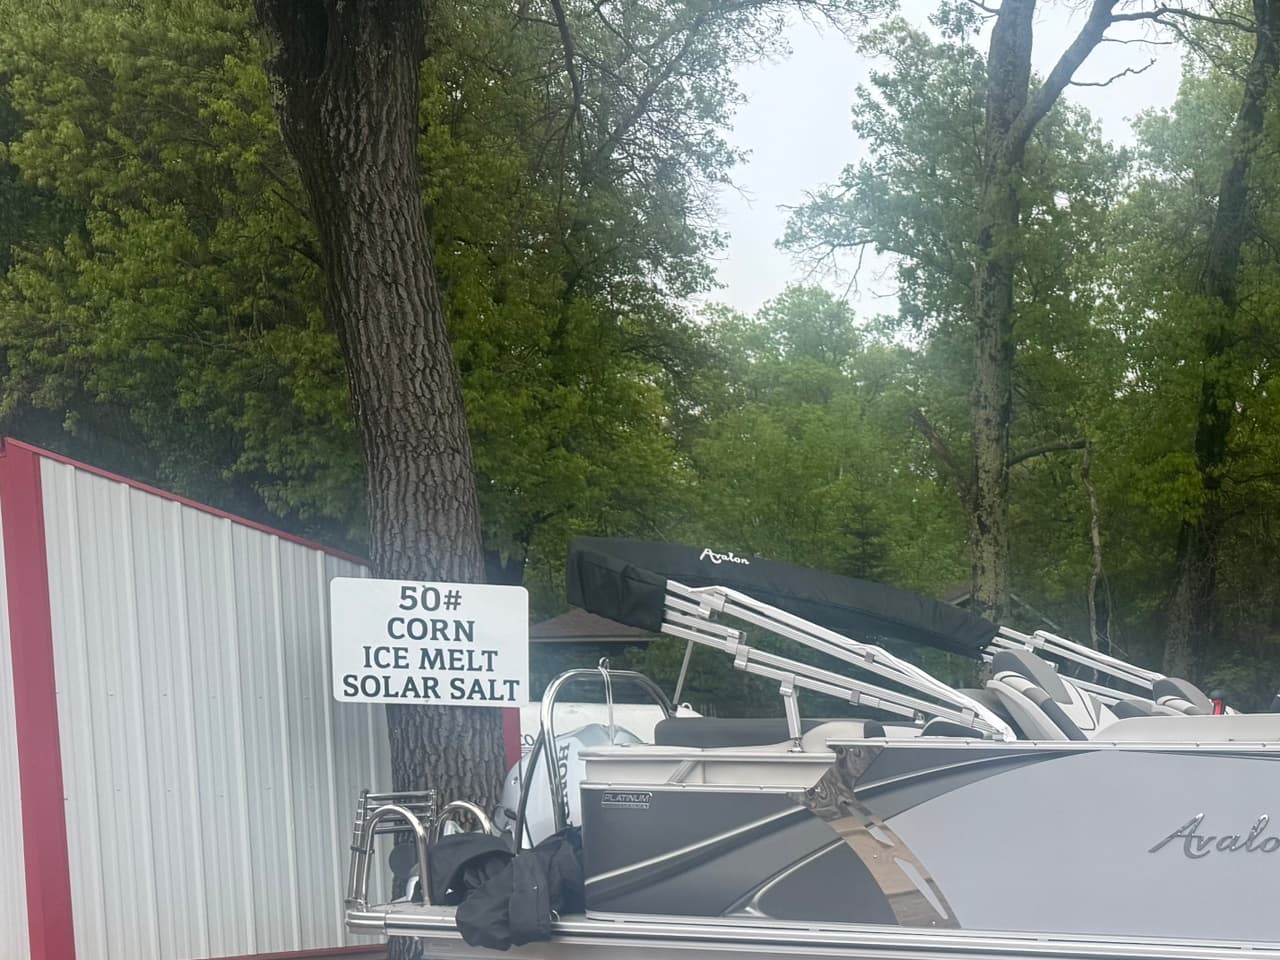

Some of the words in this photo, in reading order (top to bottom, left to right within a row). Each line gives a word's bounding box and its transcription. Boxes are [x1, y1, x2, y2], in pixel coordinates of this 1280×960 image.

[699, 548, 750, 565] Avalon
[398, 585, 462, 611] 50#
[387, 616, 475, 642] CORN
[362, 646, 410, 669] ICE
[418, 647, 498, 672] MELT
[342, 674, 441, 699] SOLAR
[450, 677, 520, 701] SALT
